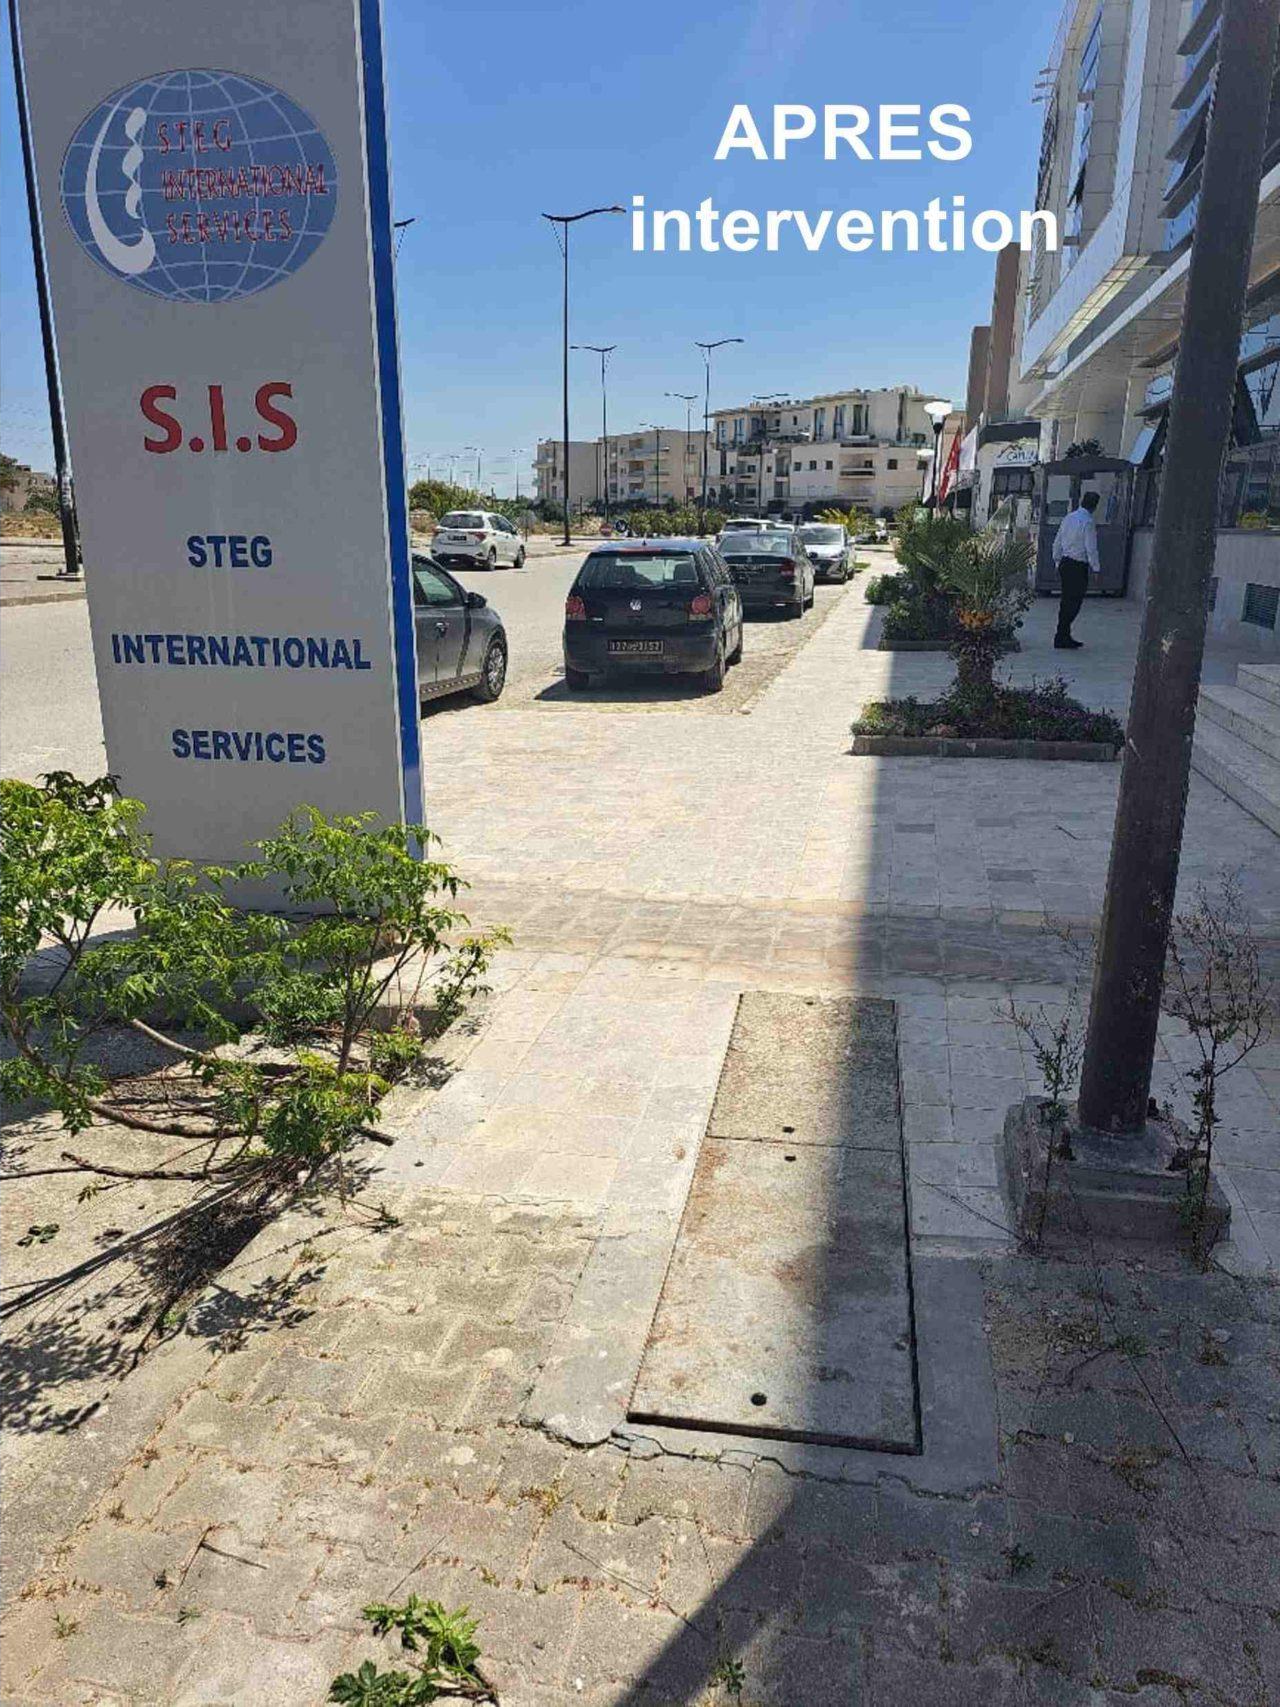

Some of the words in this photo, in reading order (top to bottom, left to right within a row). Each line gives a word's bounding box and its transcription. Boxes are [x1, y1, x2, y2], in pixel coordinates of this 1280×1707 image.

[157, 118, 233, 154] STEG
[161, 163, 329, 201] INTERNATIONAL
[167, 208, 292, 244] SERVICES
[140, 382, 298, 454] S.I.S
[186, 535, 273, 568] STEG
[111, 633, 372, 670] INTERNATIONAL
[172, 729, 326, 764] SERVICES
